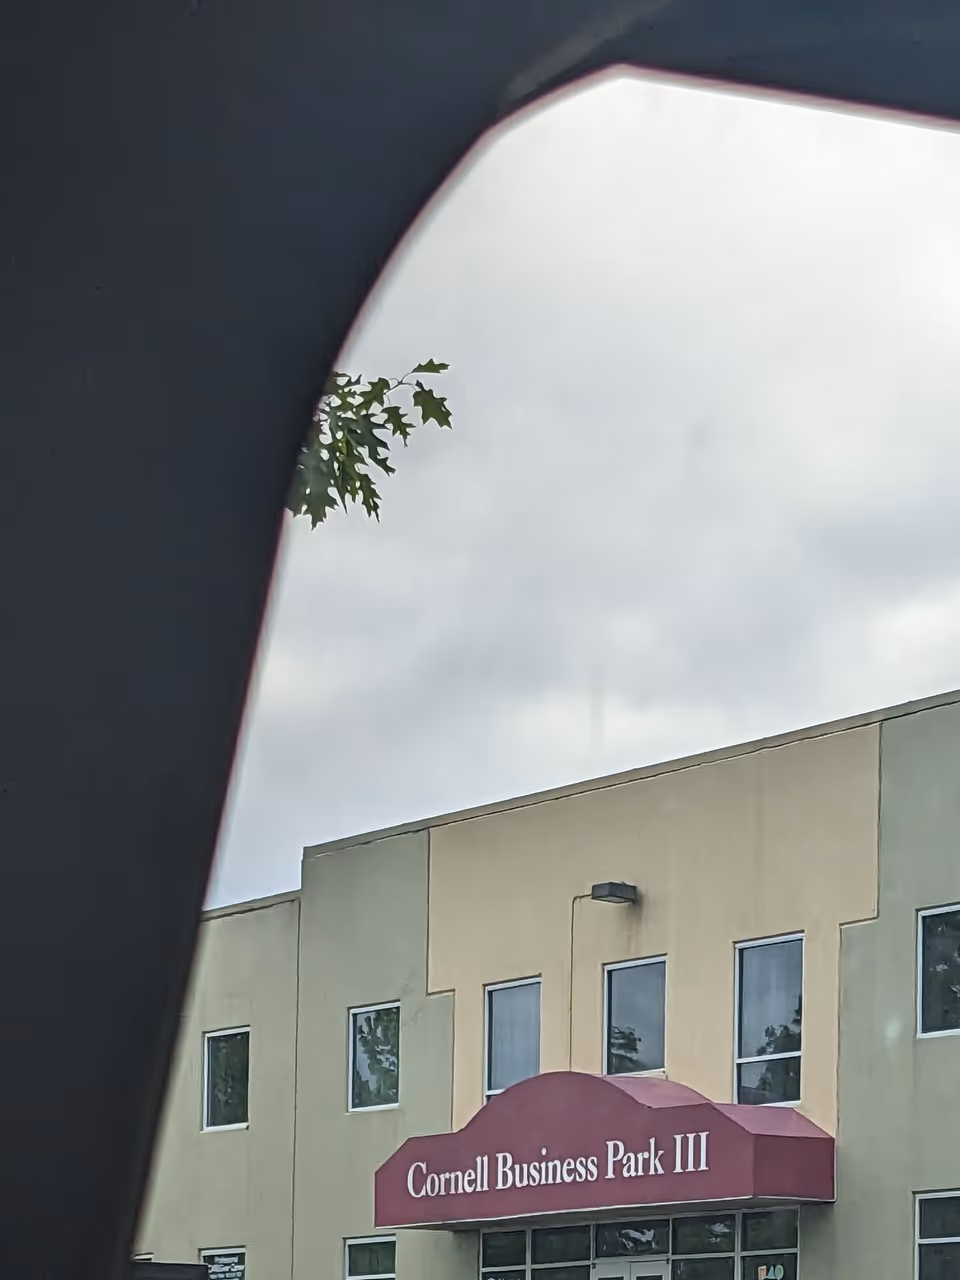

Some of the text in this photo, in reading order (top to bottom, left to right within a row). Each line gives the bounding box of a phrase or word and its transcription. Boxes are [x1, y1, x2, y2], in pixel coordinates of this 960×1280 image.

[406, 1131, 710, 1199] Cornell Business Park III
